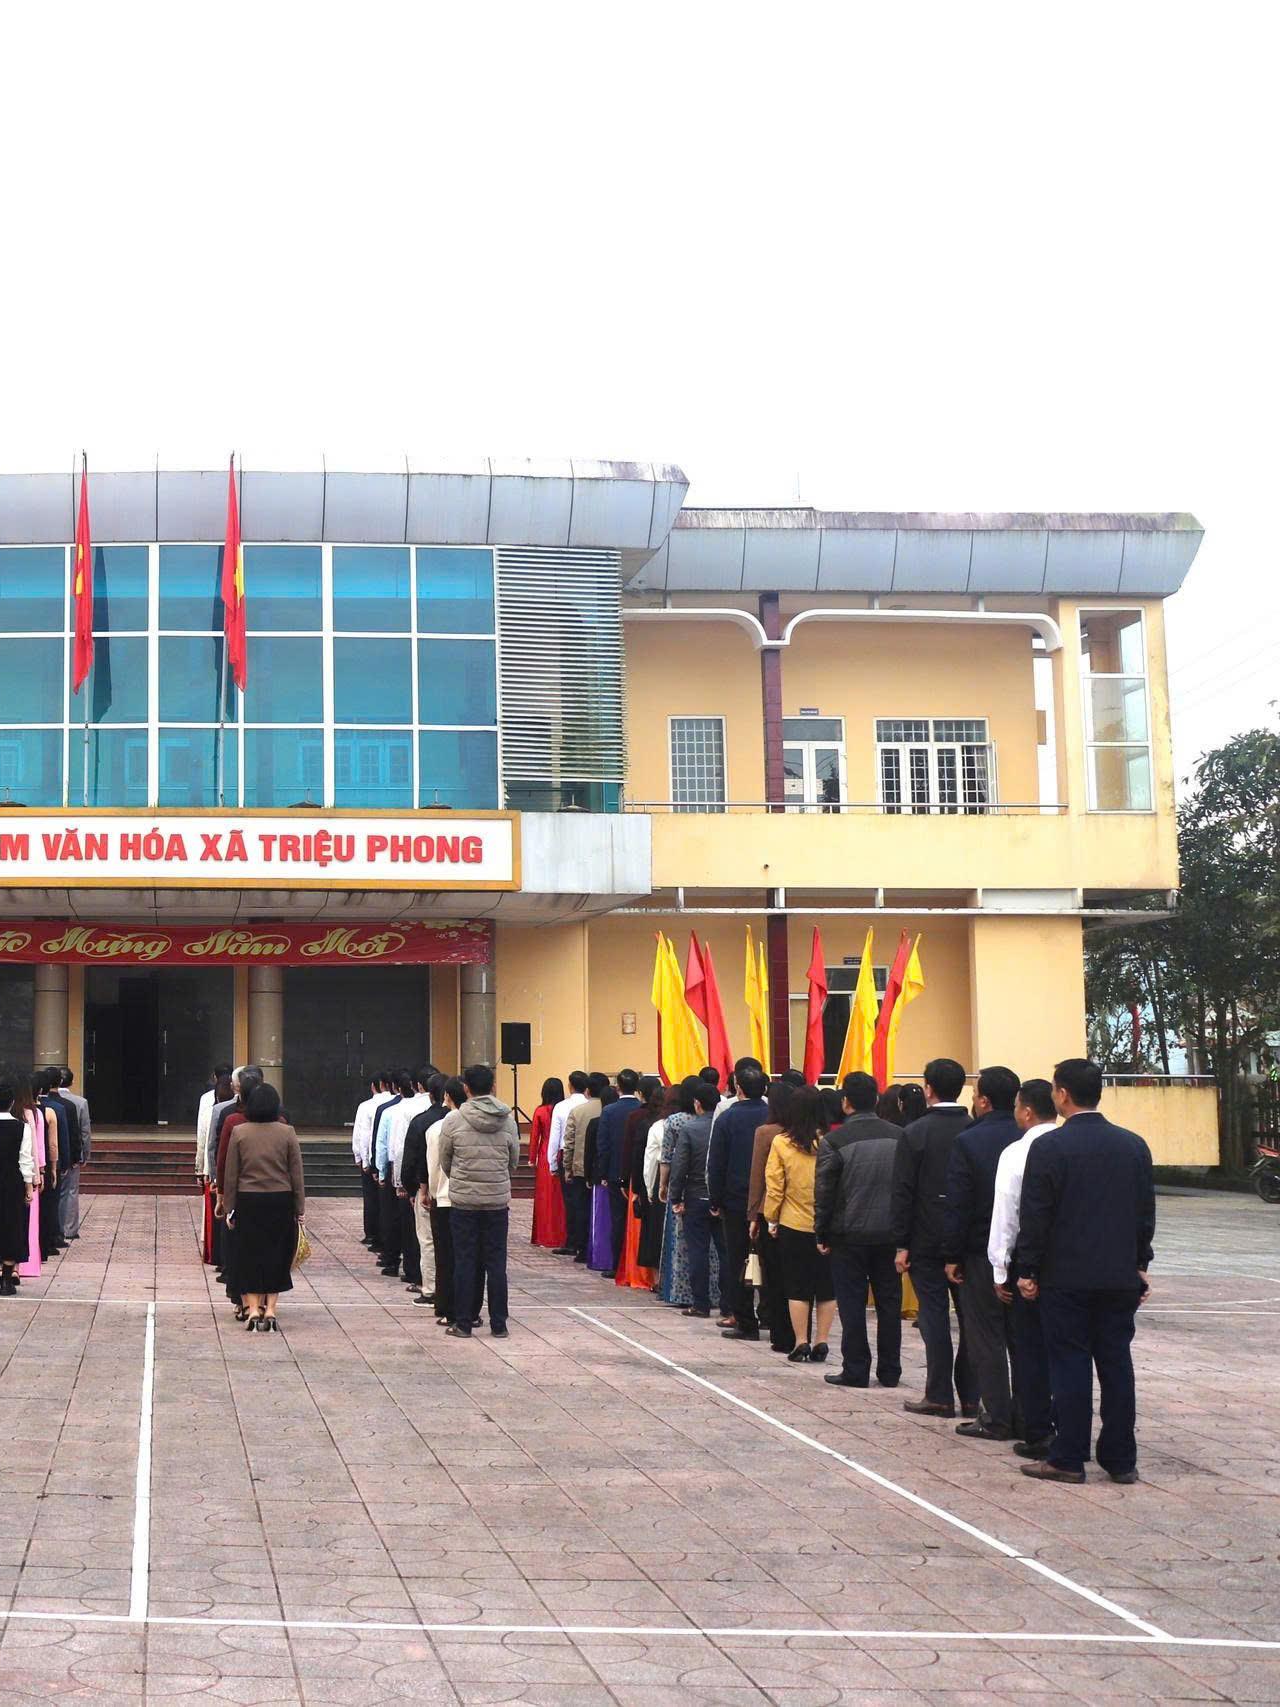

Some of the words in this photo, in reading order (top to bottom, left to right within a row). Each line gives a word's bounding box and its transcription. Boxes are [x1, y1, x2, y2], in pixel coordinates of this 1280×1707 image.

[42, 827, 109, 861] VĂN
[120, 827, 188, 861] HÓA
[200, 829, 248, 862] XÃ
[258, 829, 355, 867] TRIỆU
[367, 834, 483, 864] PHONG
[39, 925, 172, 961] Mừng
[182, 928, 291, 956] Năm
[299, 927, 406, 958] Mới
